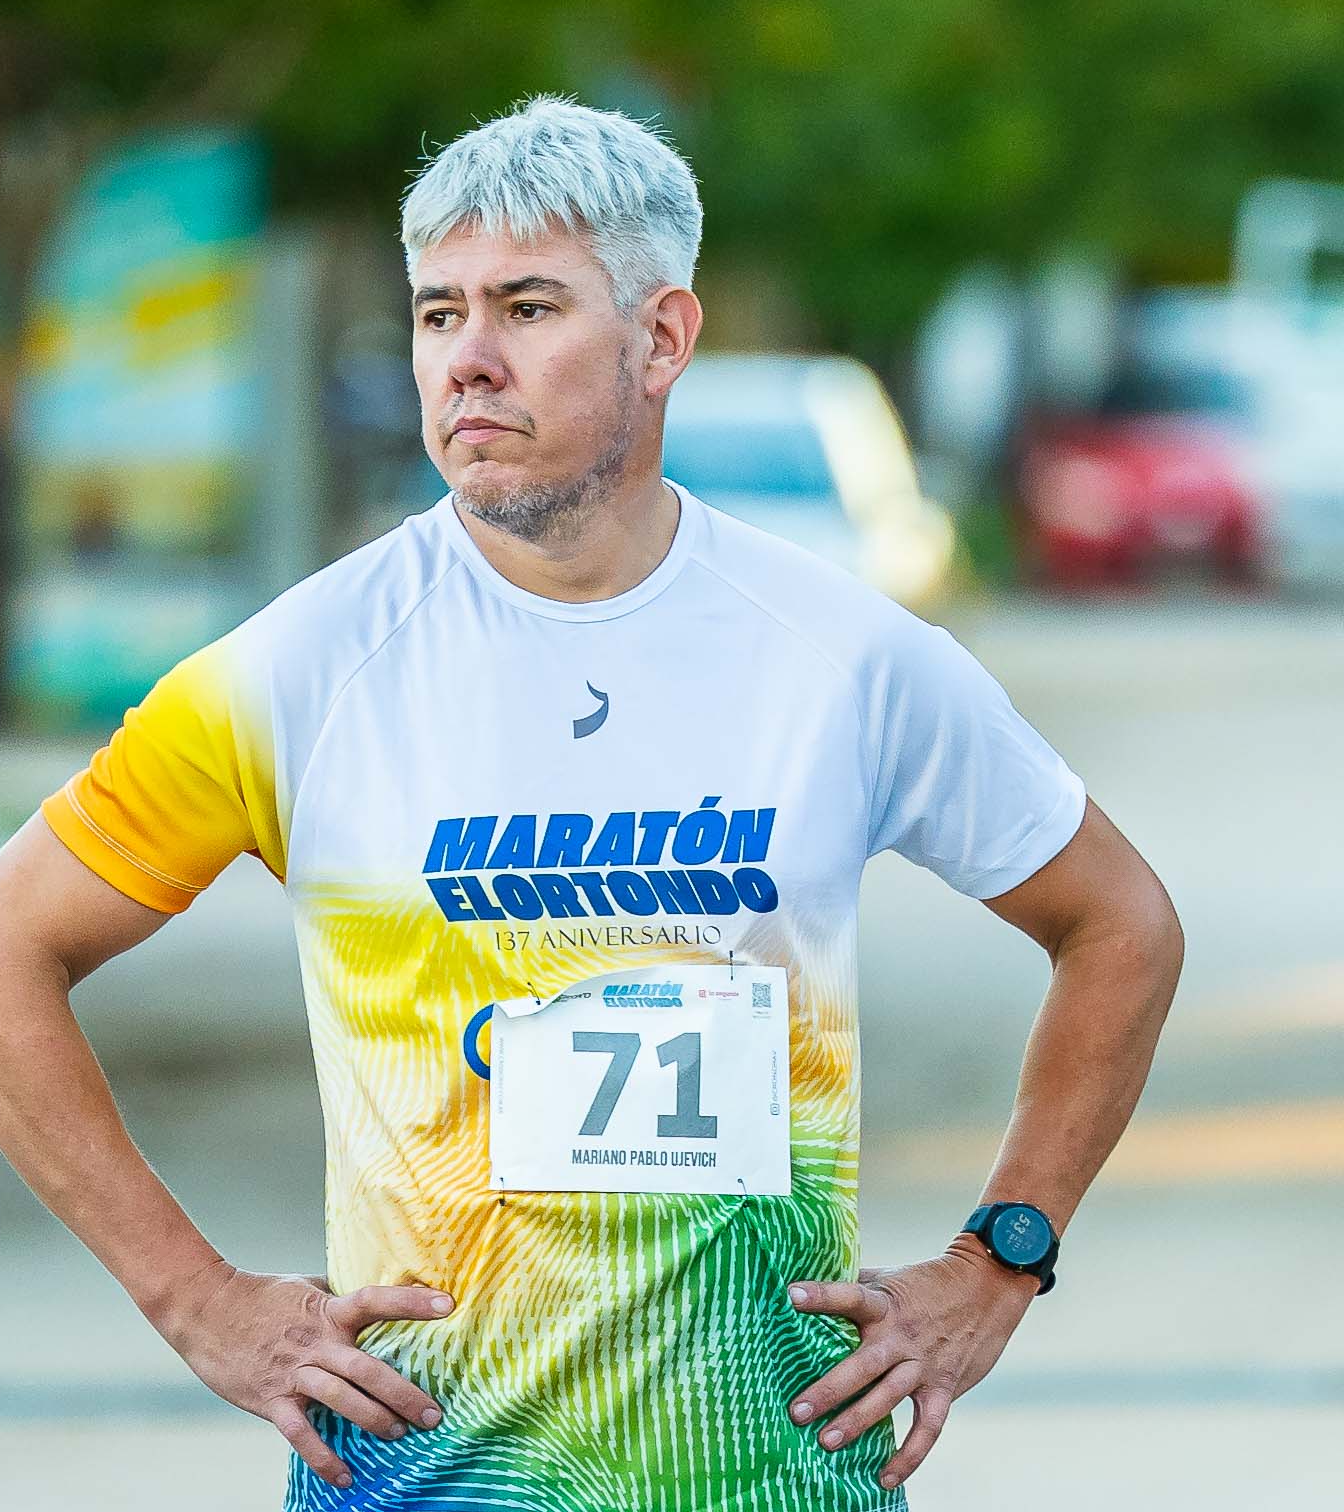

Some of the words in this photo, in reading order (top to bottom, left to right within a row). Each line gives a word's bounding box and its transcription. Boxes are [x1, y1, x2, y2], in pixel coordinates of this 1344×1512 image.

[422, 796, 776, 874] MARATÓN
[424, 867, 779, 922] ELORTONDO
[495, 930, 530, 951] 137
[540, 925, 722, 950] ANIVERSARIO
[602, 980, 684, 997] MARATÓN
[572, 1031, 718, 1139] 71
[572, 1149, 627, 1166] MARIANO
[630, 1150, 668, 1167] PABLO
[671, 1151, 717, 1168] UJEVICH
